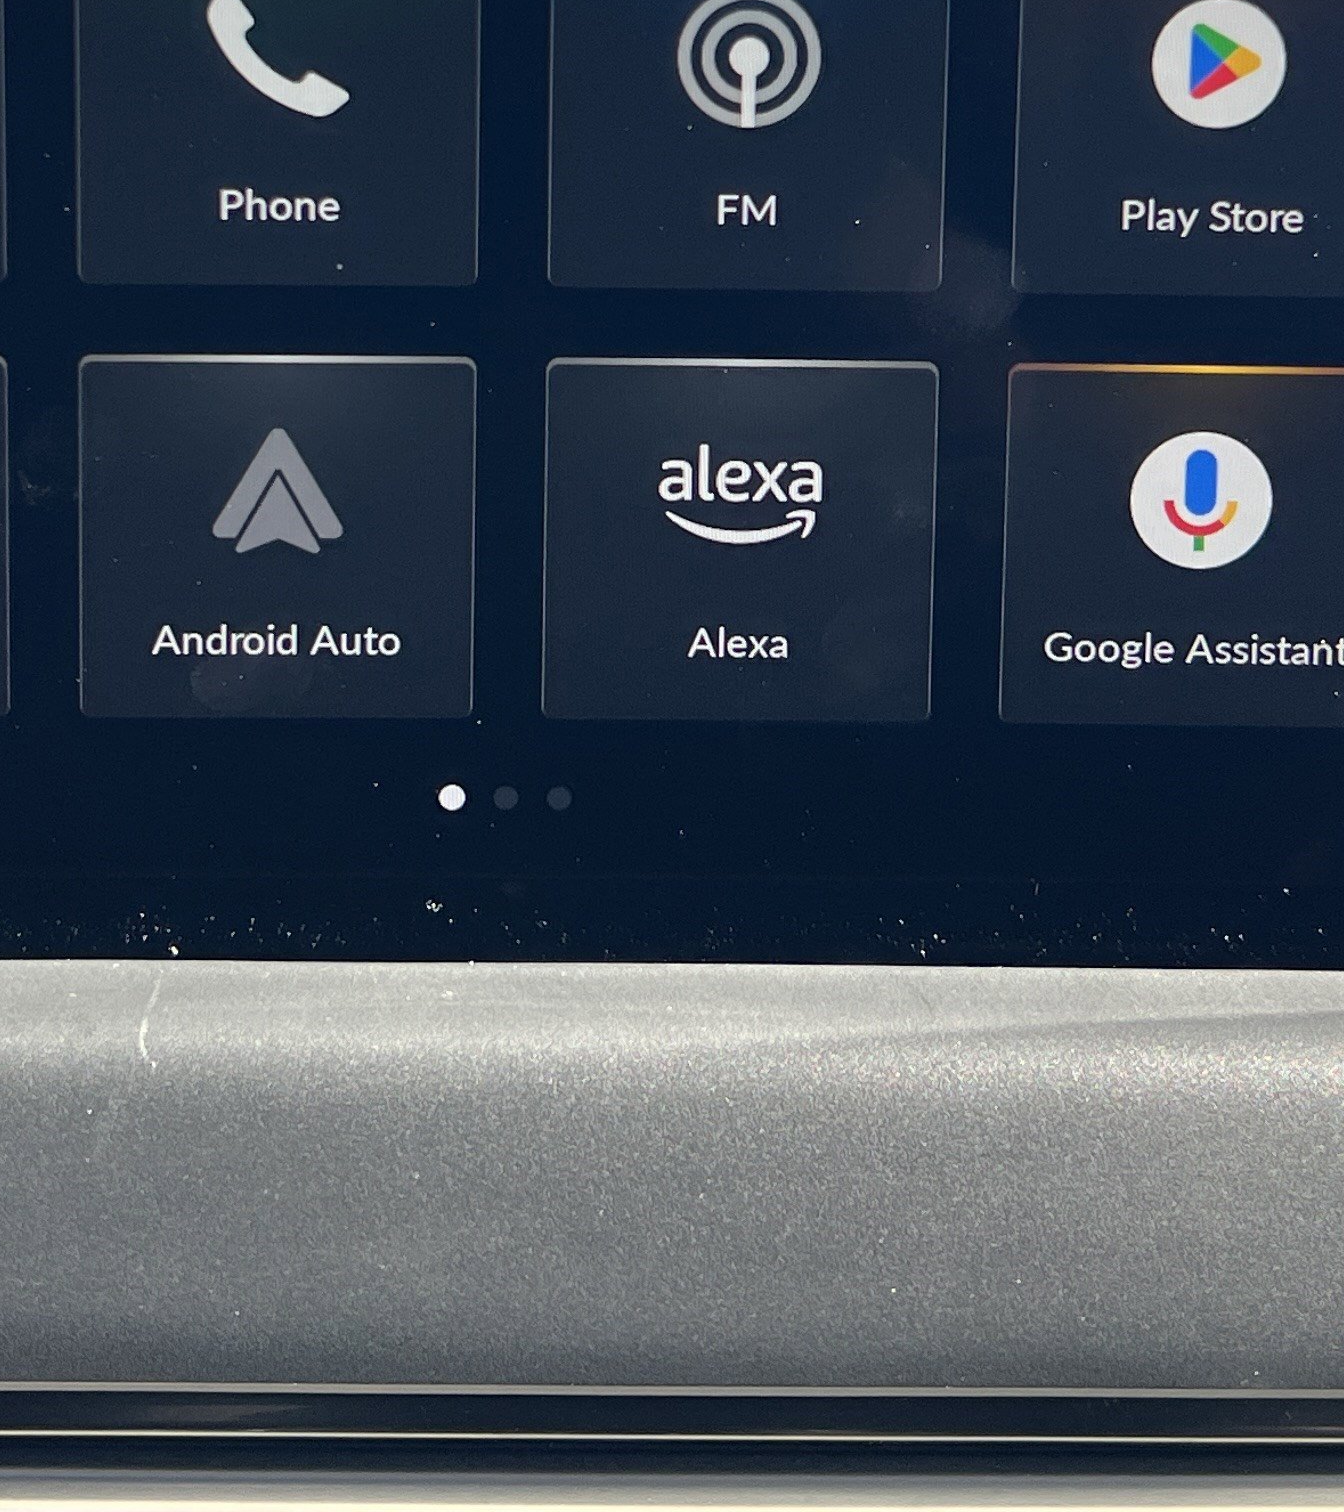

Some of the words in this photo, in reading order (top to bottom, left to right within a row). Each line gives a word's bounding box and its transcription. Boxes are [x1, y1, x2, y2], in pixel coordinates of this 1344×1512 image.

[219, 187, 341, 222] Phone
[717, 194, 777, 226] FM
[1121, 198, 1200, 238] Play
[1208, 200, 1304, 234] Store
[658, 443, 823, 503] alexa
[151, 623, 298, 656] Android
[309, 625, 401, 656] Auto
[687, 625, 788, 659] Alexa
[1044, 631, 1175, 669] Google
